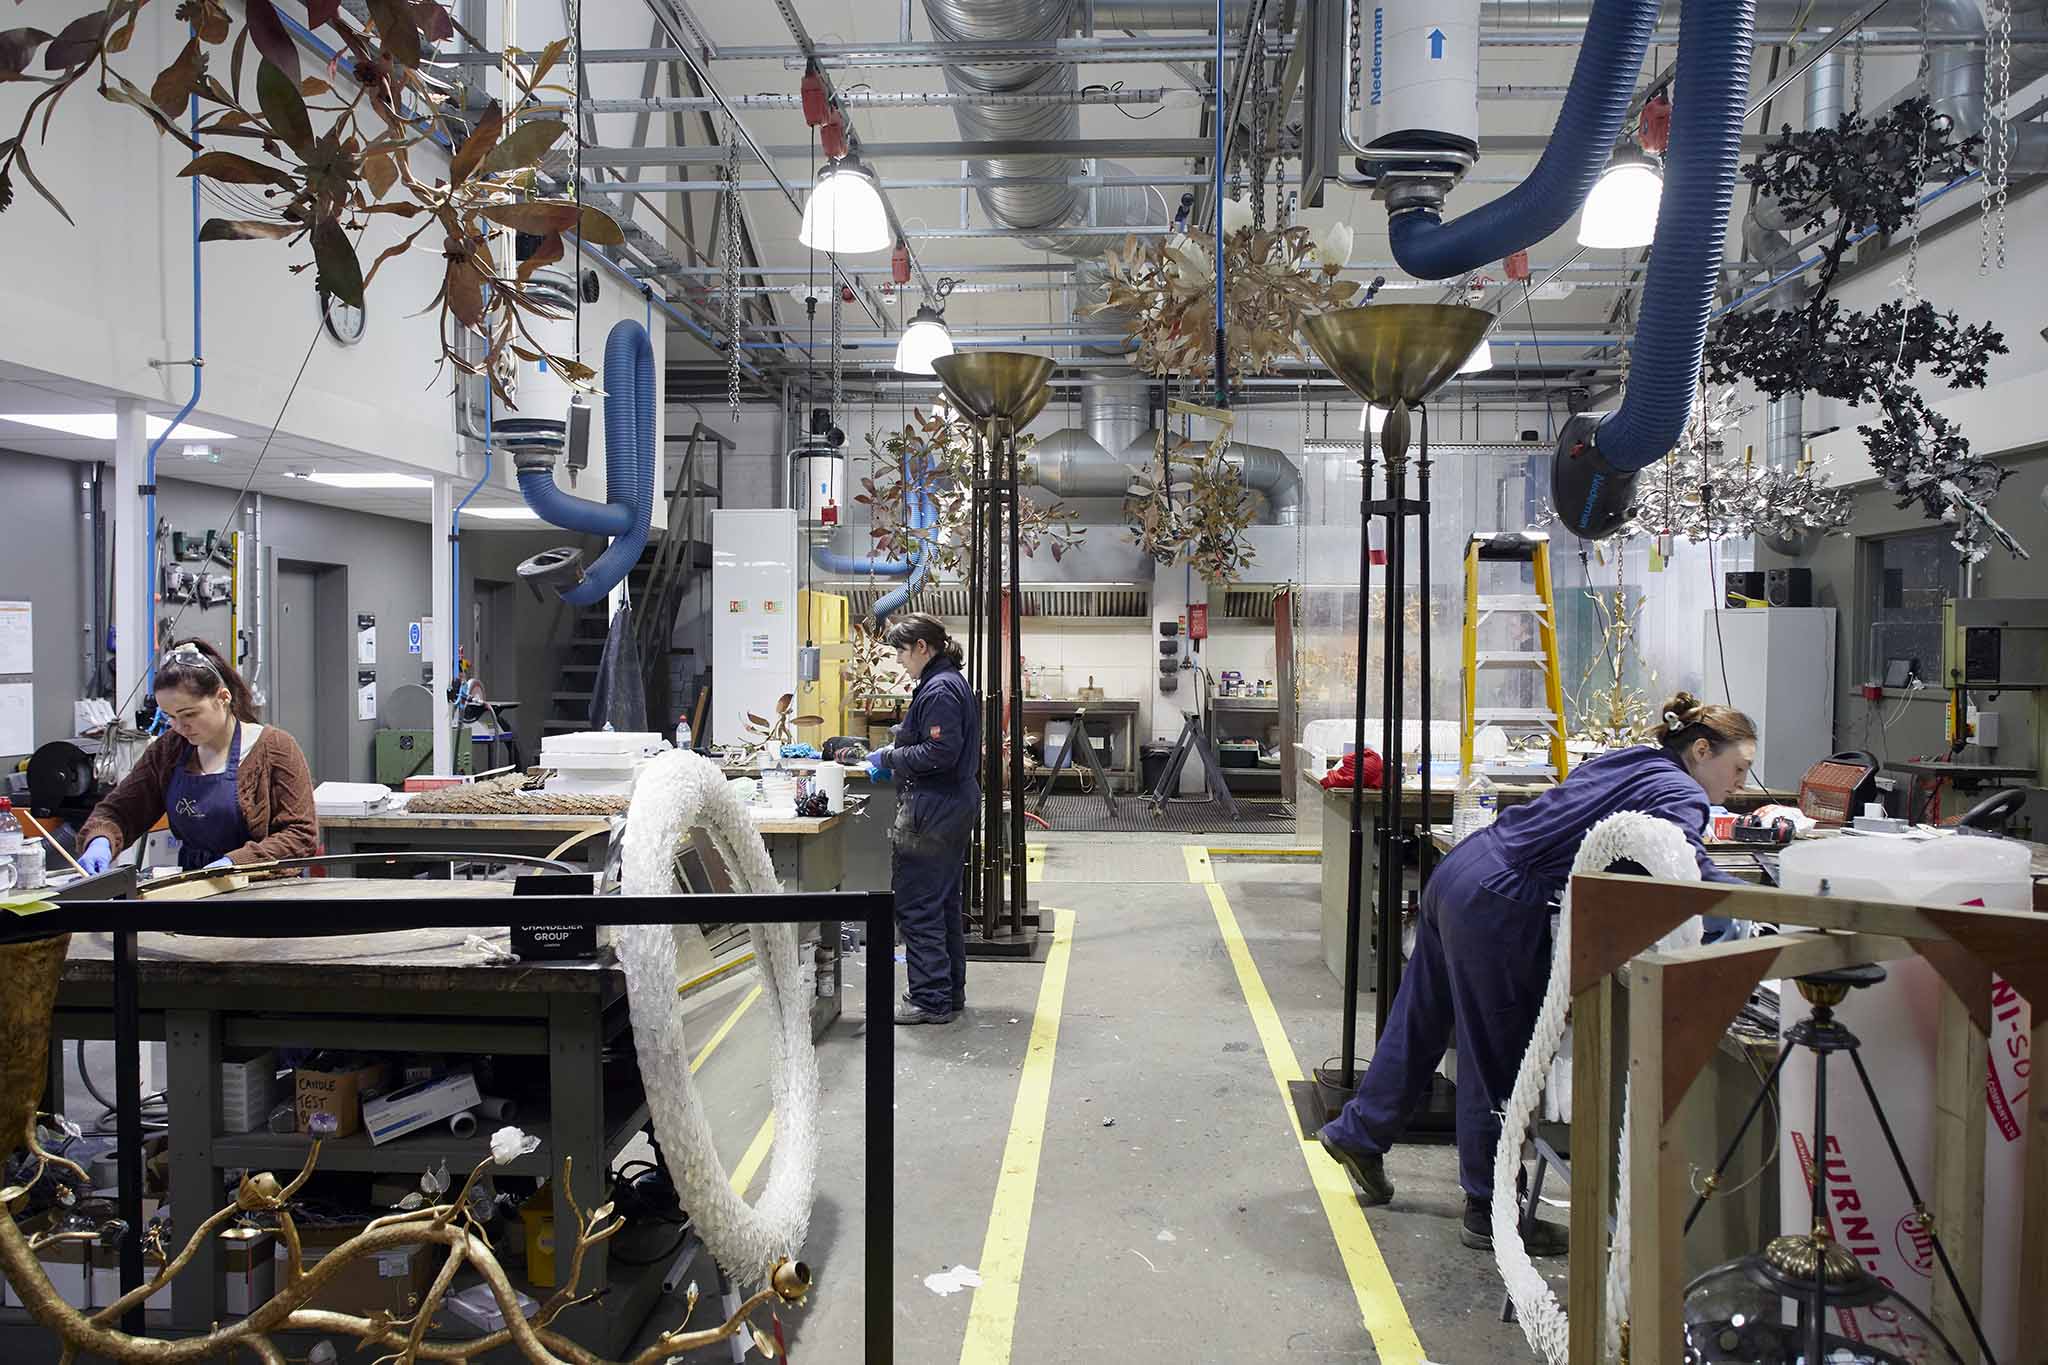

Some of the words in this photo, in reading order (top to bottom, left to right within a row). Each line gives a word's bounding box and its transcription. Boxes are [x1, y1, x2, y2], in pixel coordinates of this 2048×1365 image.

[1371, 8, 1382, 105] Nederman
[534, 932, 569, 941] GROUP
[299, 1078, 336, 1091] CANDLE
[298, 1095, 327, 1109] TEST
